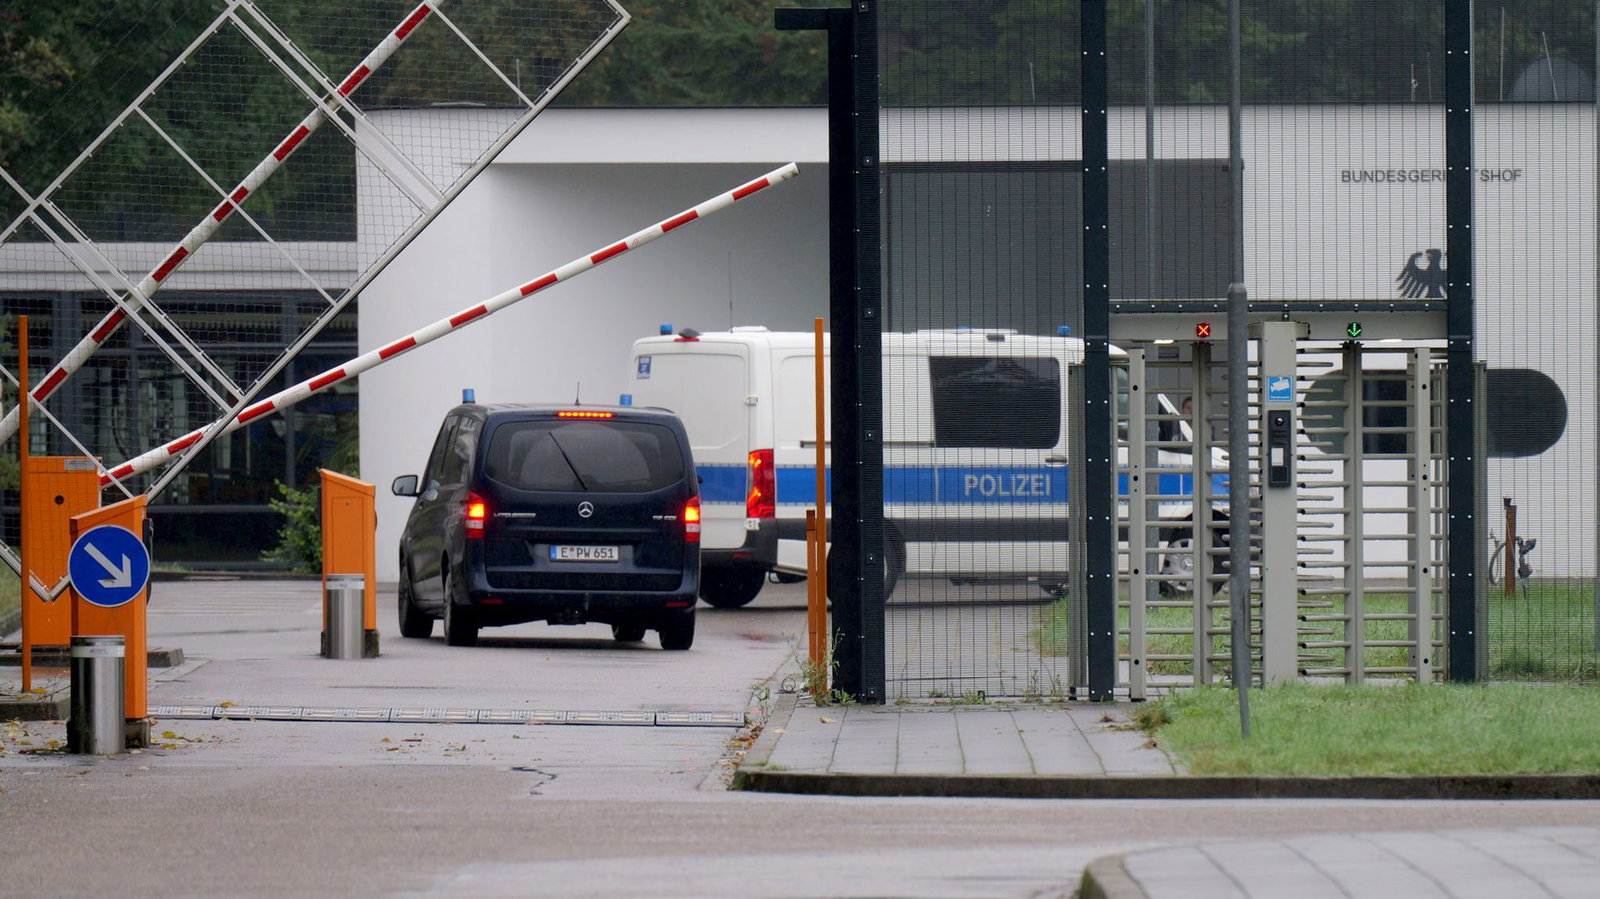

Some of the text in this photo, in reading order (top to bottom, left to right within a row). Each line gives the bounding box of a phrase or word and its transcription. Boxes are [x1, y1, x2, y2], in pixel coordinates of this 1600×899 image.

[1341, 169, 1522, 183] BUNDESGERISHOF
[963, 474, 1051, 496] POLIZEI
[561, 547, 614, 558] E PW 651
